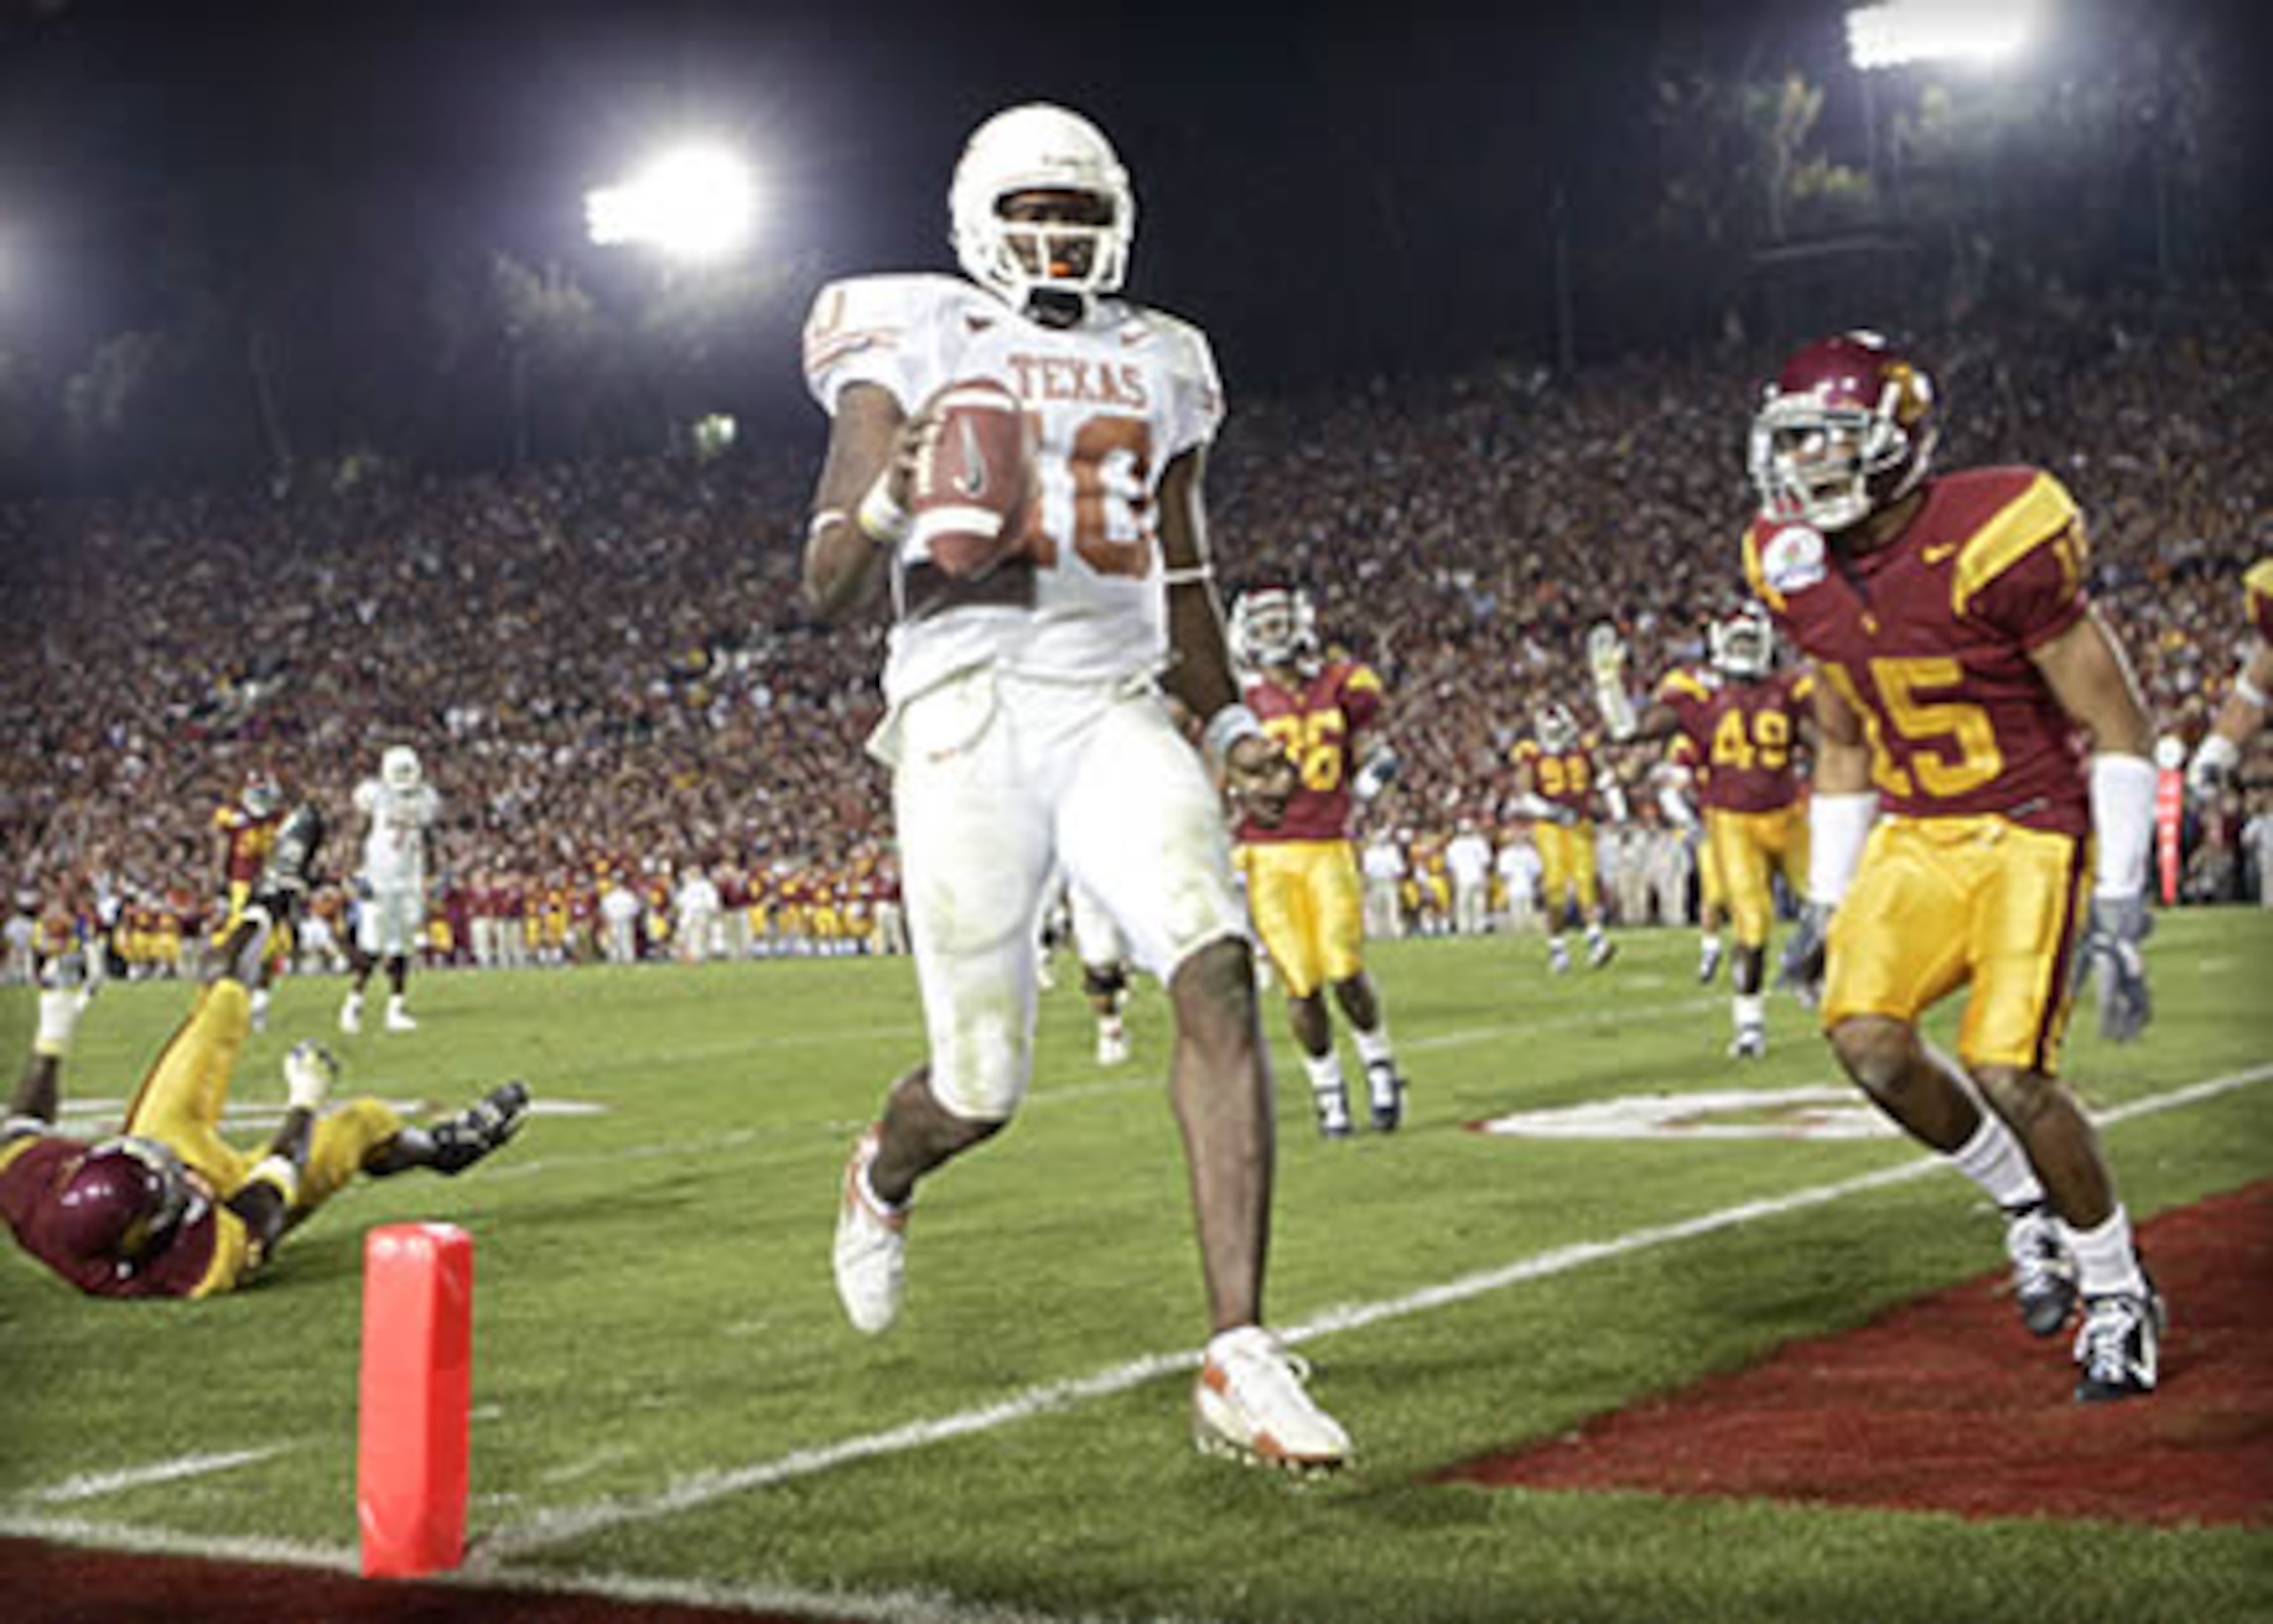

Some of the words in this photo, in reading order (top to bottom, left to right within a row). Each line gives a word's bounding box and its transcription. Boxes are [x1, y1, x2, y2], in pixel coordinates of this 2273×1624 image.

[1008, 353, 1147, 408] TEXAS
[1711, 708, 1788, 770] 49
[1823, 657, 2003, 796] 15
